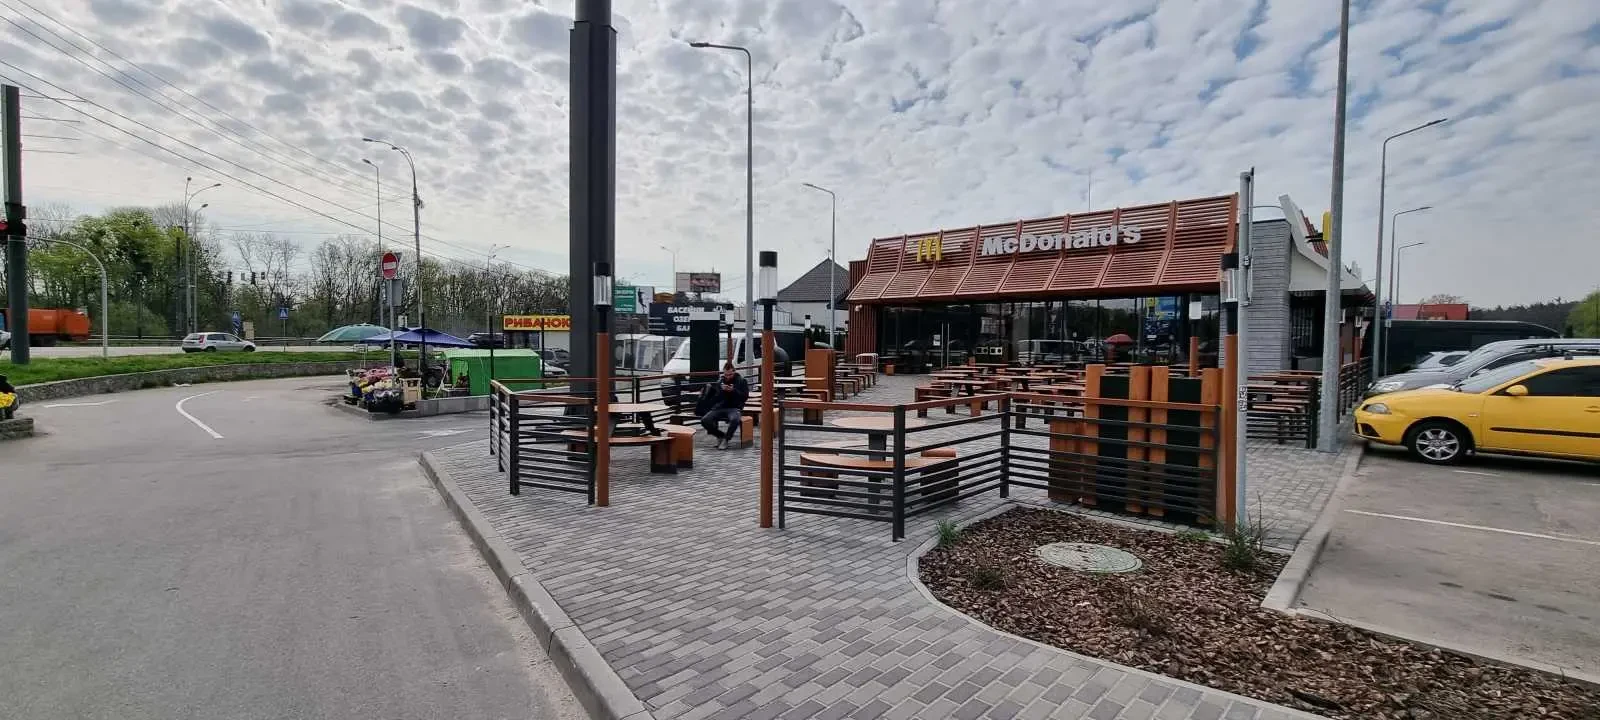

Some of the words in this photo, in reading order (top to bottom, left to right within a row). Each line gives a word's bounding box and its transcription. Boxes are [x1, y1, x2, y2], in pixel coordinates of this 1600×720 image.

[981, 225, 1141, 255] McDonald's
[504, 318, 569, 328] РИБАЧОК
[673, 315, 690, 323] ОЗЕ
